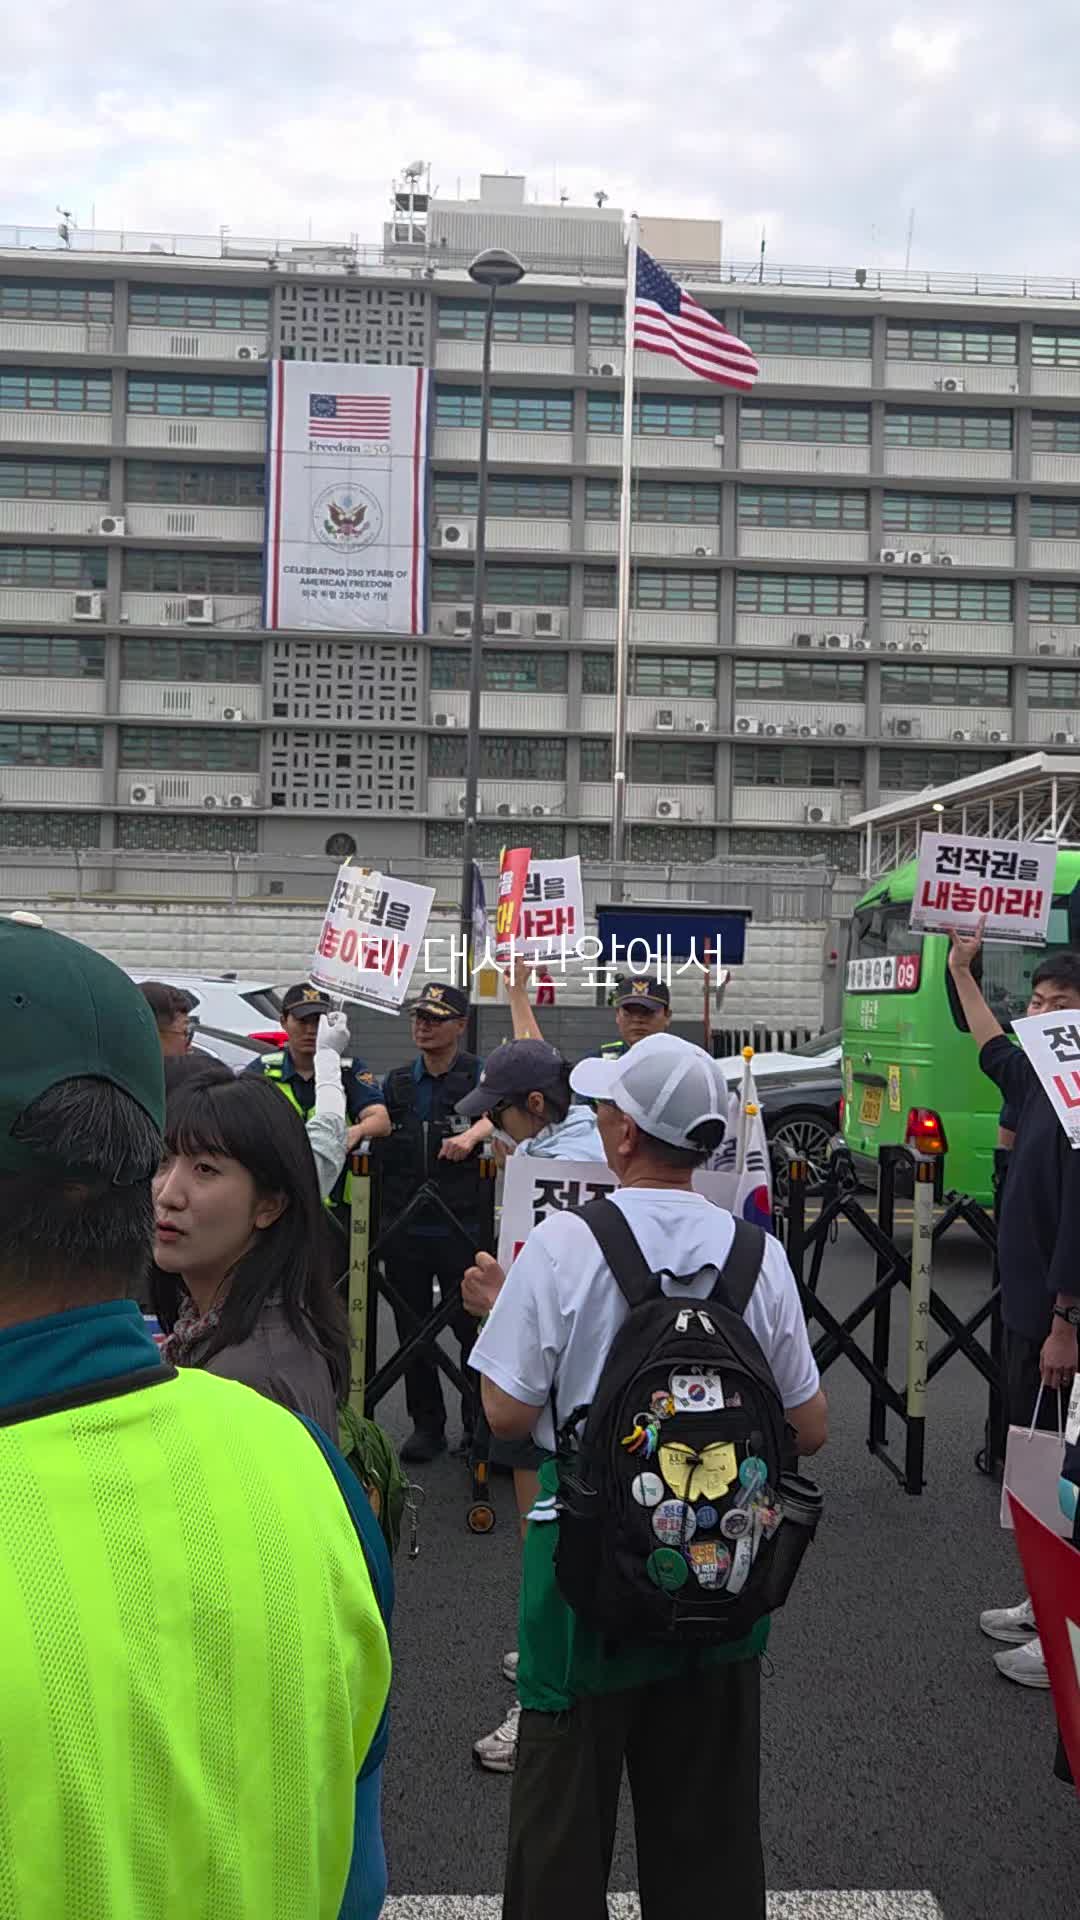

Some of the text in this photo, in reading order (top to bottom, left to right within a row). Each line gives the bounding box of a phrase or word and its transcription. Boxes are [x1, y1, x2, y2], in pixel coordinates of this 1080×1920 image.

[309, 440, 361, 453] Freedom
[283, 566, 408, 579] CELEBRATING 250 YEARS OF
[299, 577, 393, 589] AMERICAN FREEDOM
[936, 845, 1039, 881] 전작권을
[920, 880, 1044, 919] 내놓아라!
[897, 964, 915, 987] 09
